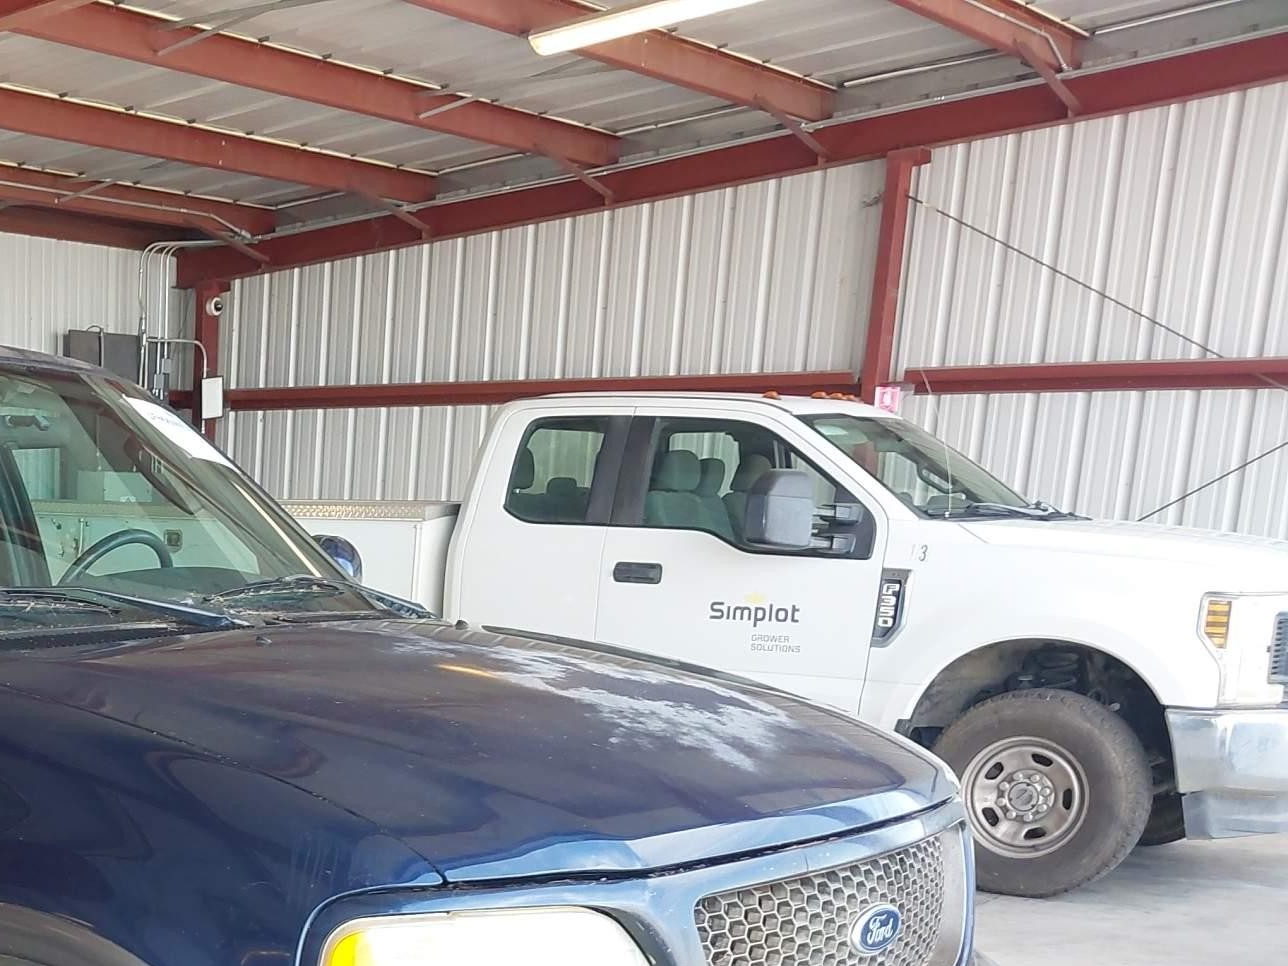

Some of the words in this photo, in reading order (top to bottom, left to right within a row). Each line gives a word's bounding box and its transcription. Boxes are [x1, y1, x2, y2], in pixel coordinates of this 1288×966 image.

[709, 601, 801, 628] Simplot
[750, 643, 801, 653] SOLUTIONS
[751, 634, 791, 644] GROWER
[866, 913, 894, 945] Ford
